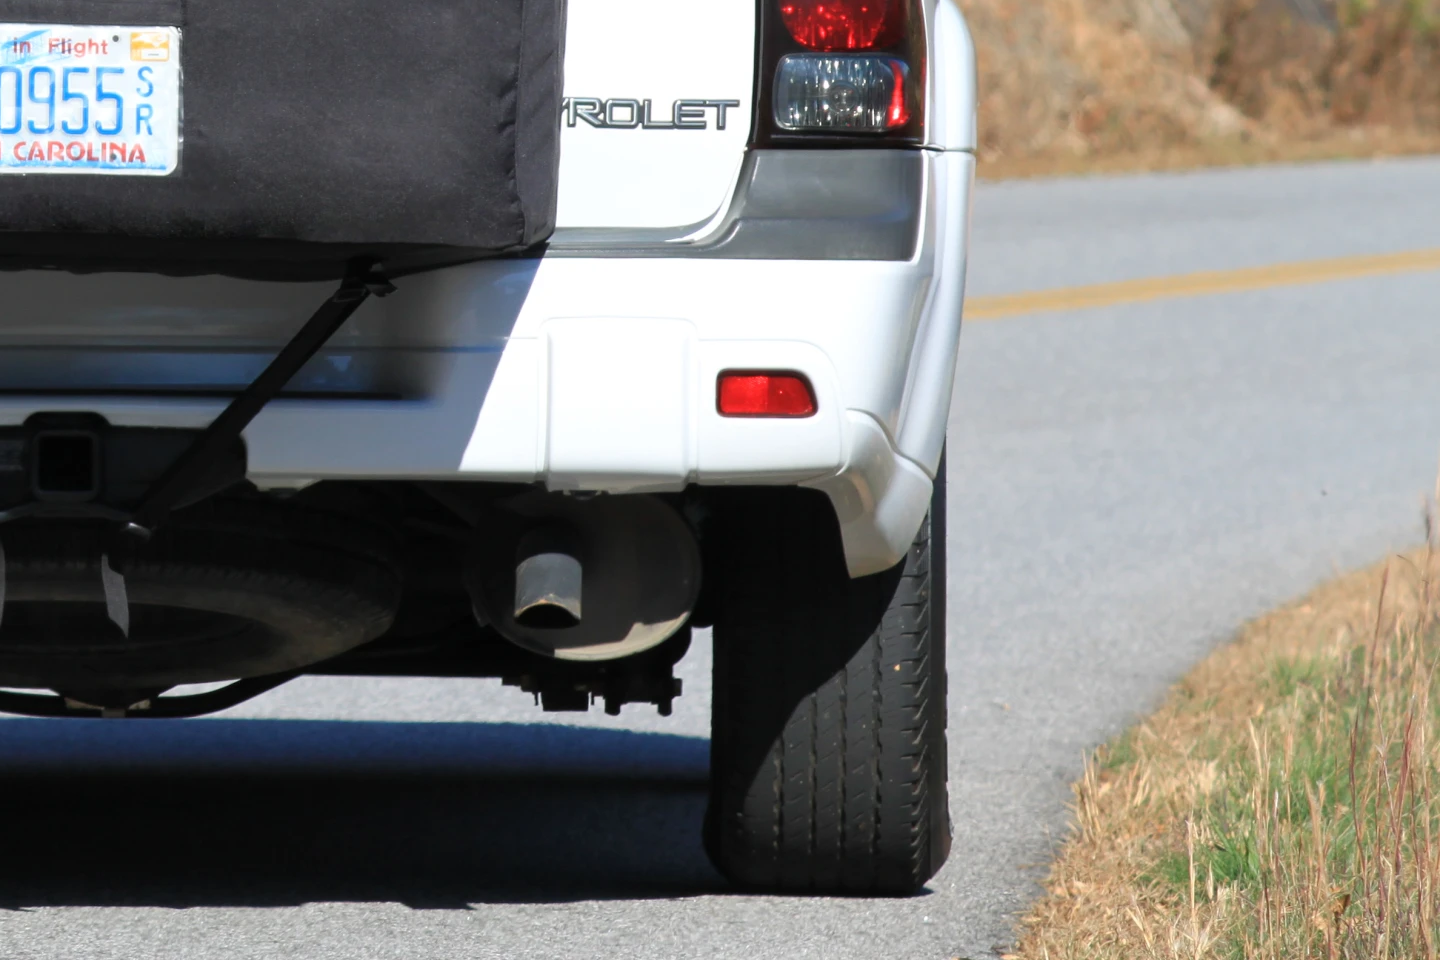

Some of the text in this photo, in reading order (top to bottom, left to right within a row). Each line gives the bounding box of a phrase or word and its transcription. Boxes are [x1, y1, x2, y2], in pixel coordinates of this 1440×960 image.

[13, 36, 31, 53] in
[48, 38, 108, 58] Flight
[562, 97, 740, 130] ROLET
[13, 141, 146, 163] CAROLINA
